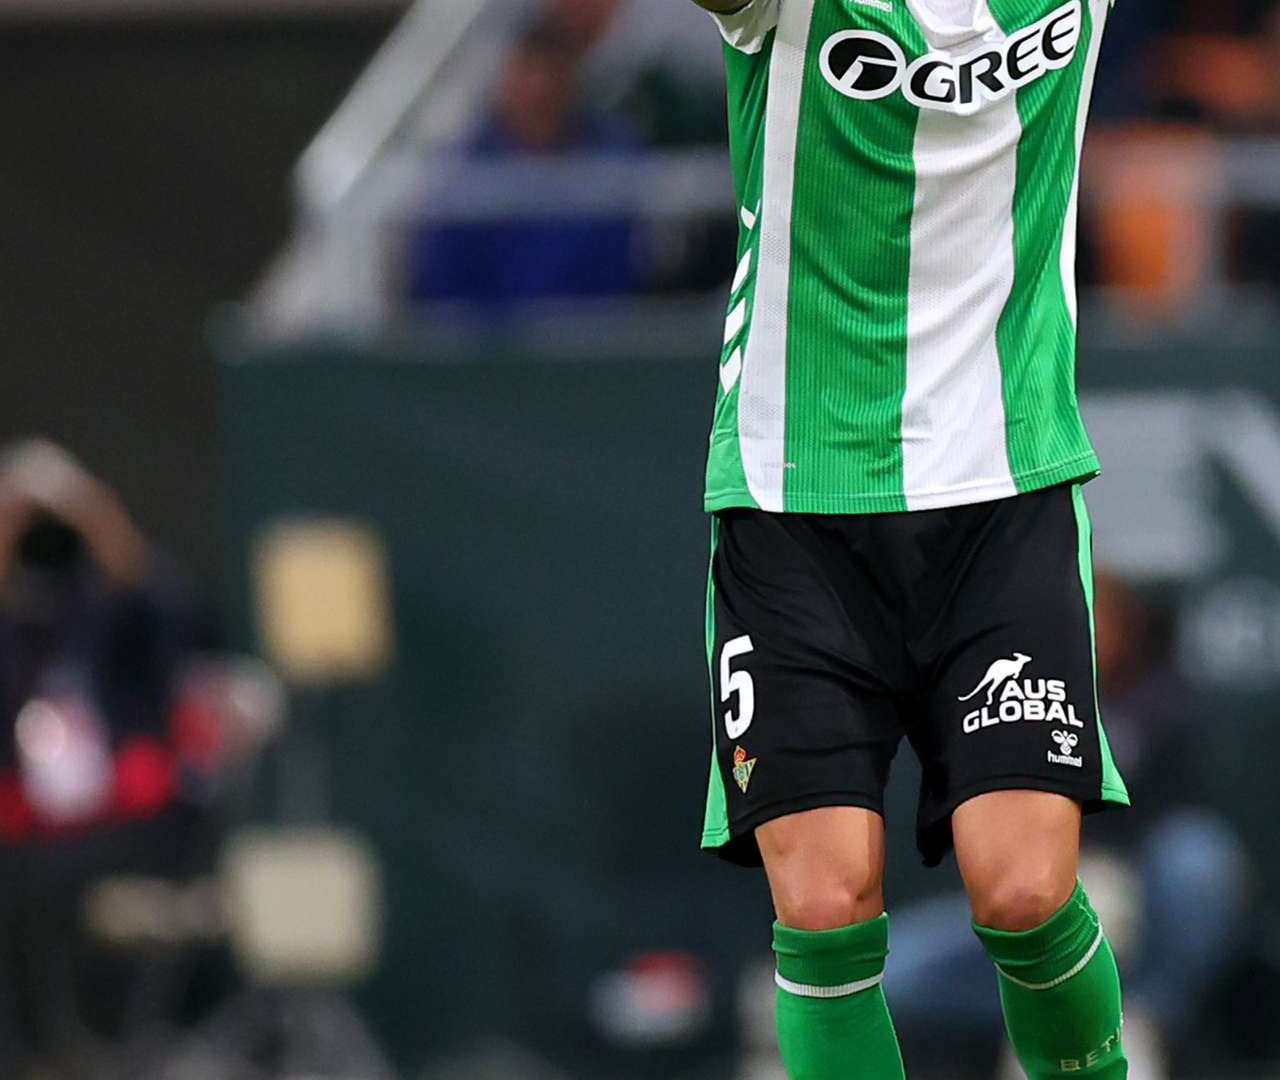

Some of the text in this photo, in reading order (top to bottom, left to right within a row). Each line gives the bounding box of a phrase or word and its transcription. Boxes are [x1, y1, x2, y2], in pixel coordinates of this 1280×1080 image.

[910, 8, 1076, 104] GREE
[720, 634, 754, 739] 5
[962, 699, 1084, 734] GLOBAL
[999, 678, 1067, 702] AUS
